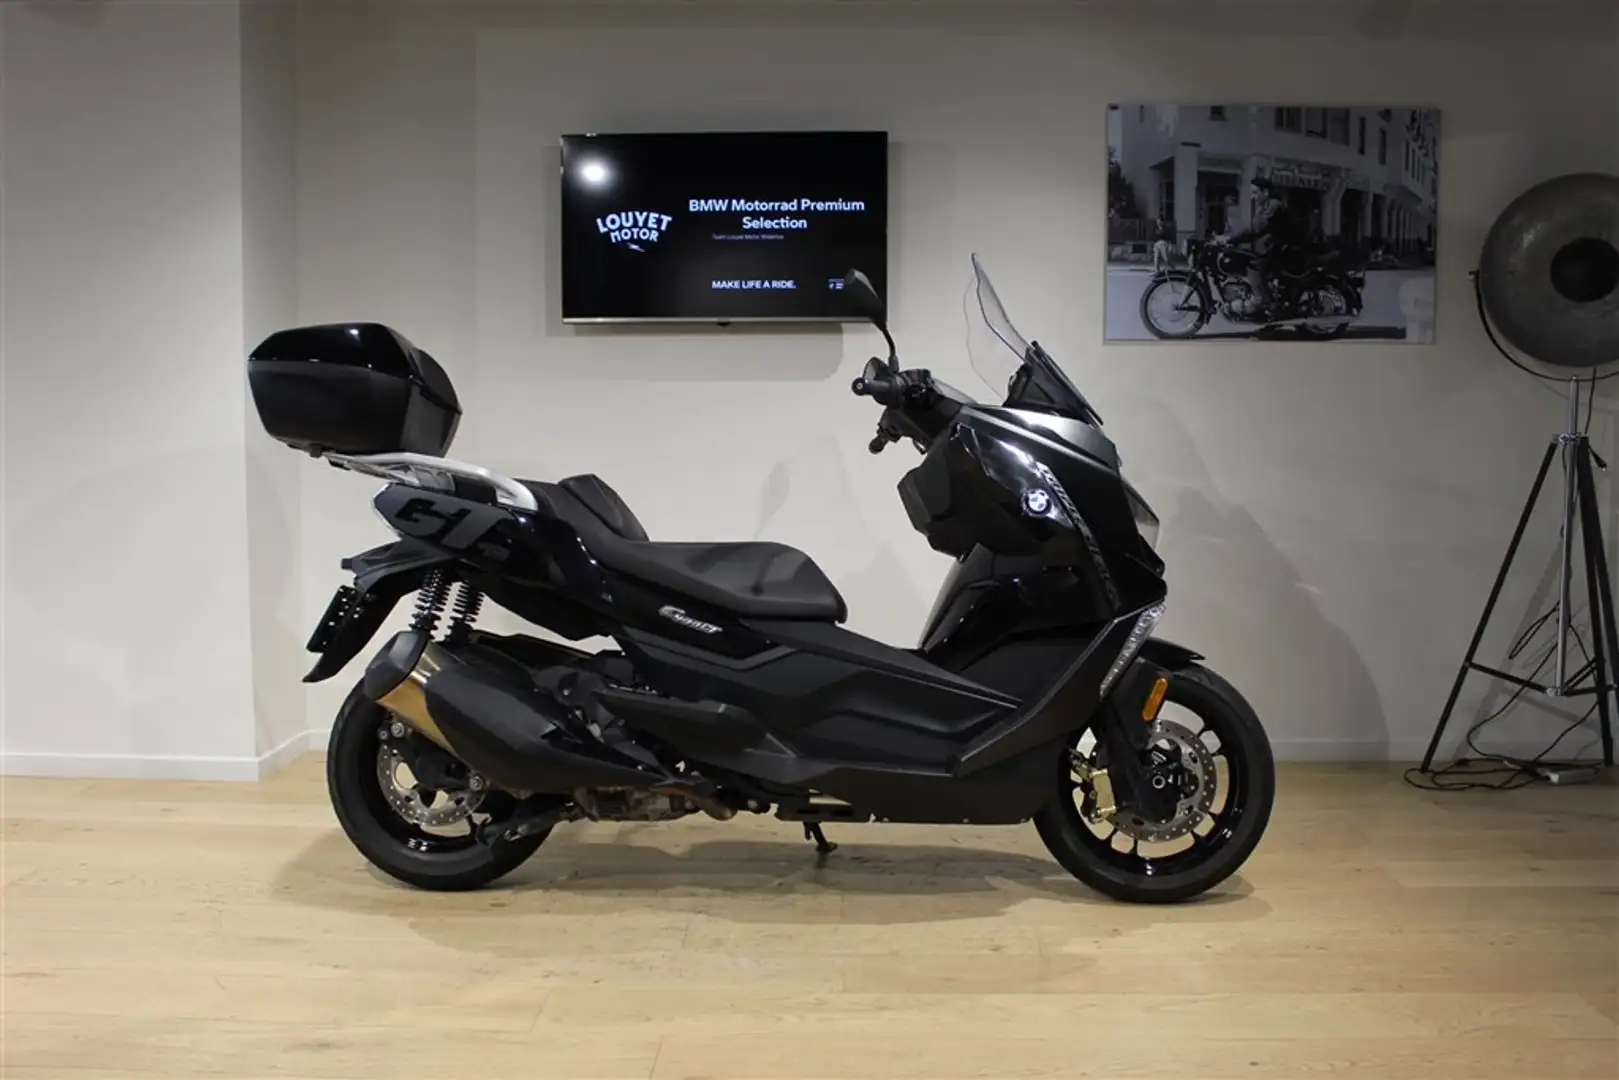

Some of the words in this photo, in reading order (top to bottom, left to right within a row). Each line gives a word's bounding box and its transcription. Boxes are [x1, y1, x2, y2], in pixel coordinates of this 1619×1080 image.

[689, 199, 728, 212] BMW
[731, 199, 798, 212] Motorrad
[801, 198, 865, 212] Premium
[596, 211, 672, 233] LOUYET
[742, 216, 808, 230] Selection
[610, 228, 658, 243] MOTOR
[712, 280, 740, 289] MAKE
[742, 280, 761, 289] LIFE
[763, 280, 771, 289] A
[772, 280, 796, 289] RIDE.
